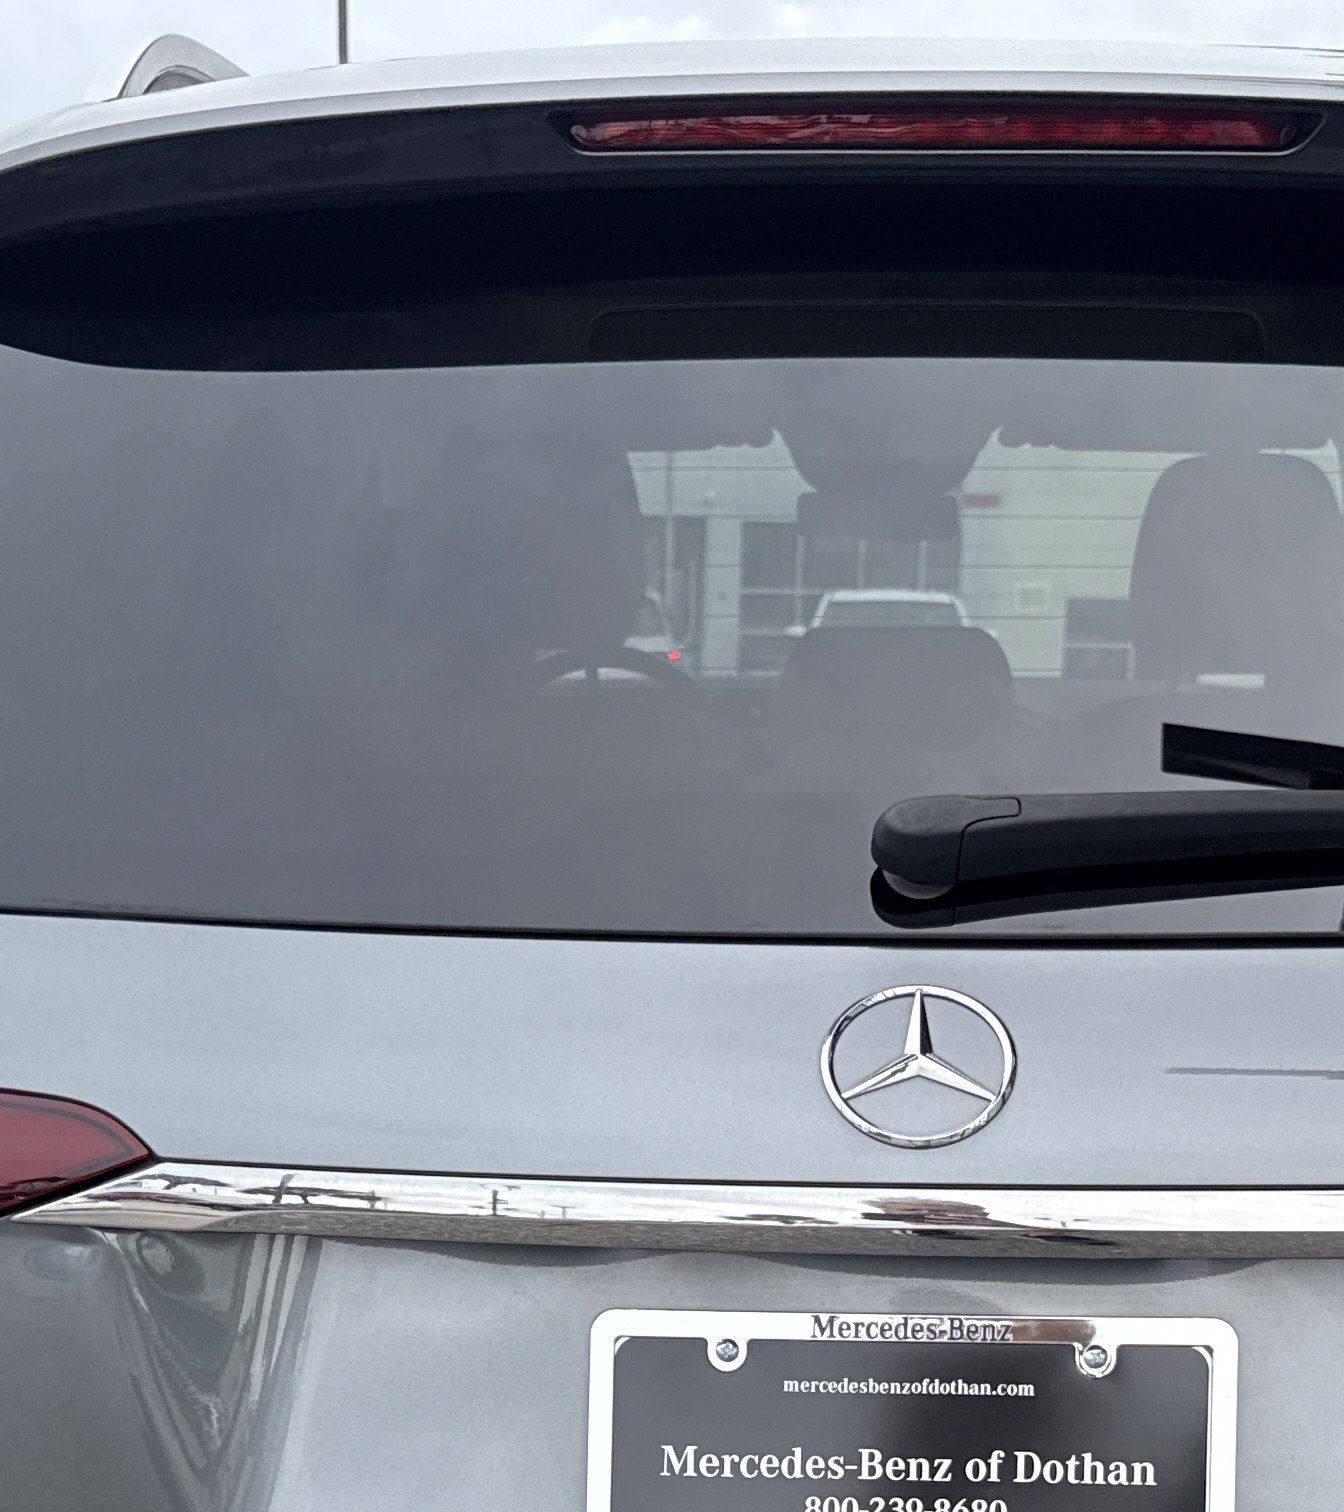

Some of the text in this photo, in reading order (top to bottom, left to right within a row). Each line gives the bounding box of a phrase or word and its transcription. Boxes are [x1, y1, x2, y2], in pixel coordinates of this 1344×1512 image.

[810, 1314, 1014, 1342] Mercedes-Benz
[783, 1376, 1036, 1398] mercedesbenzofdothan.com
[659, 1444, 1157, 1487] Mercedes-Benz of Dothan
